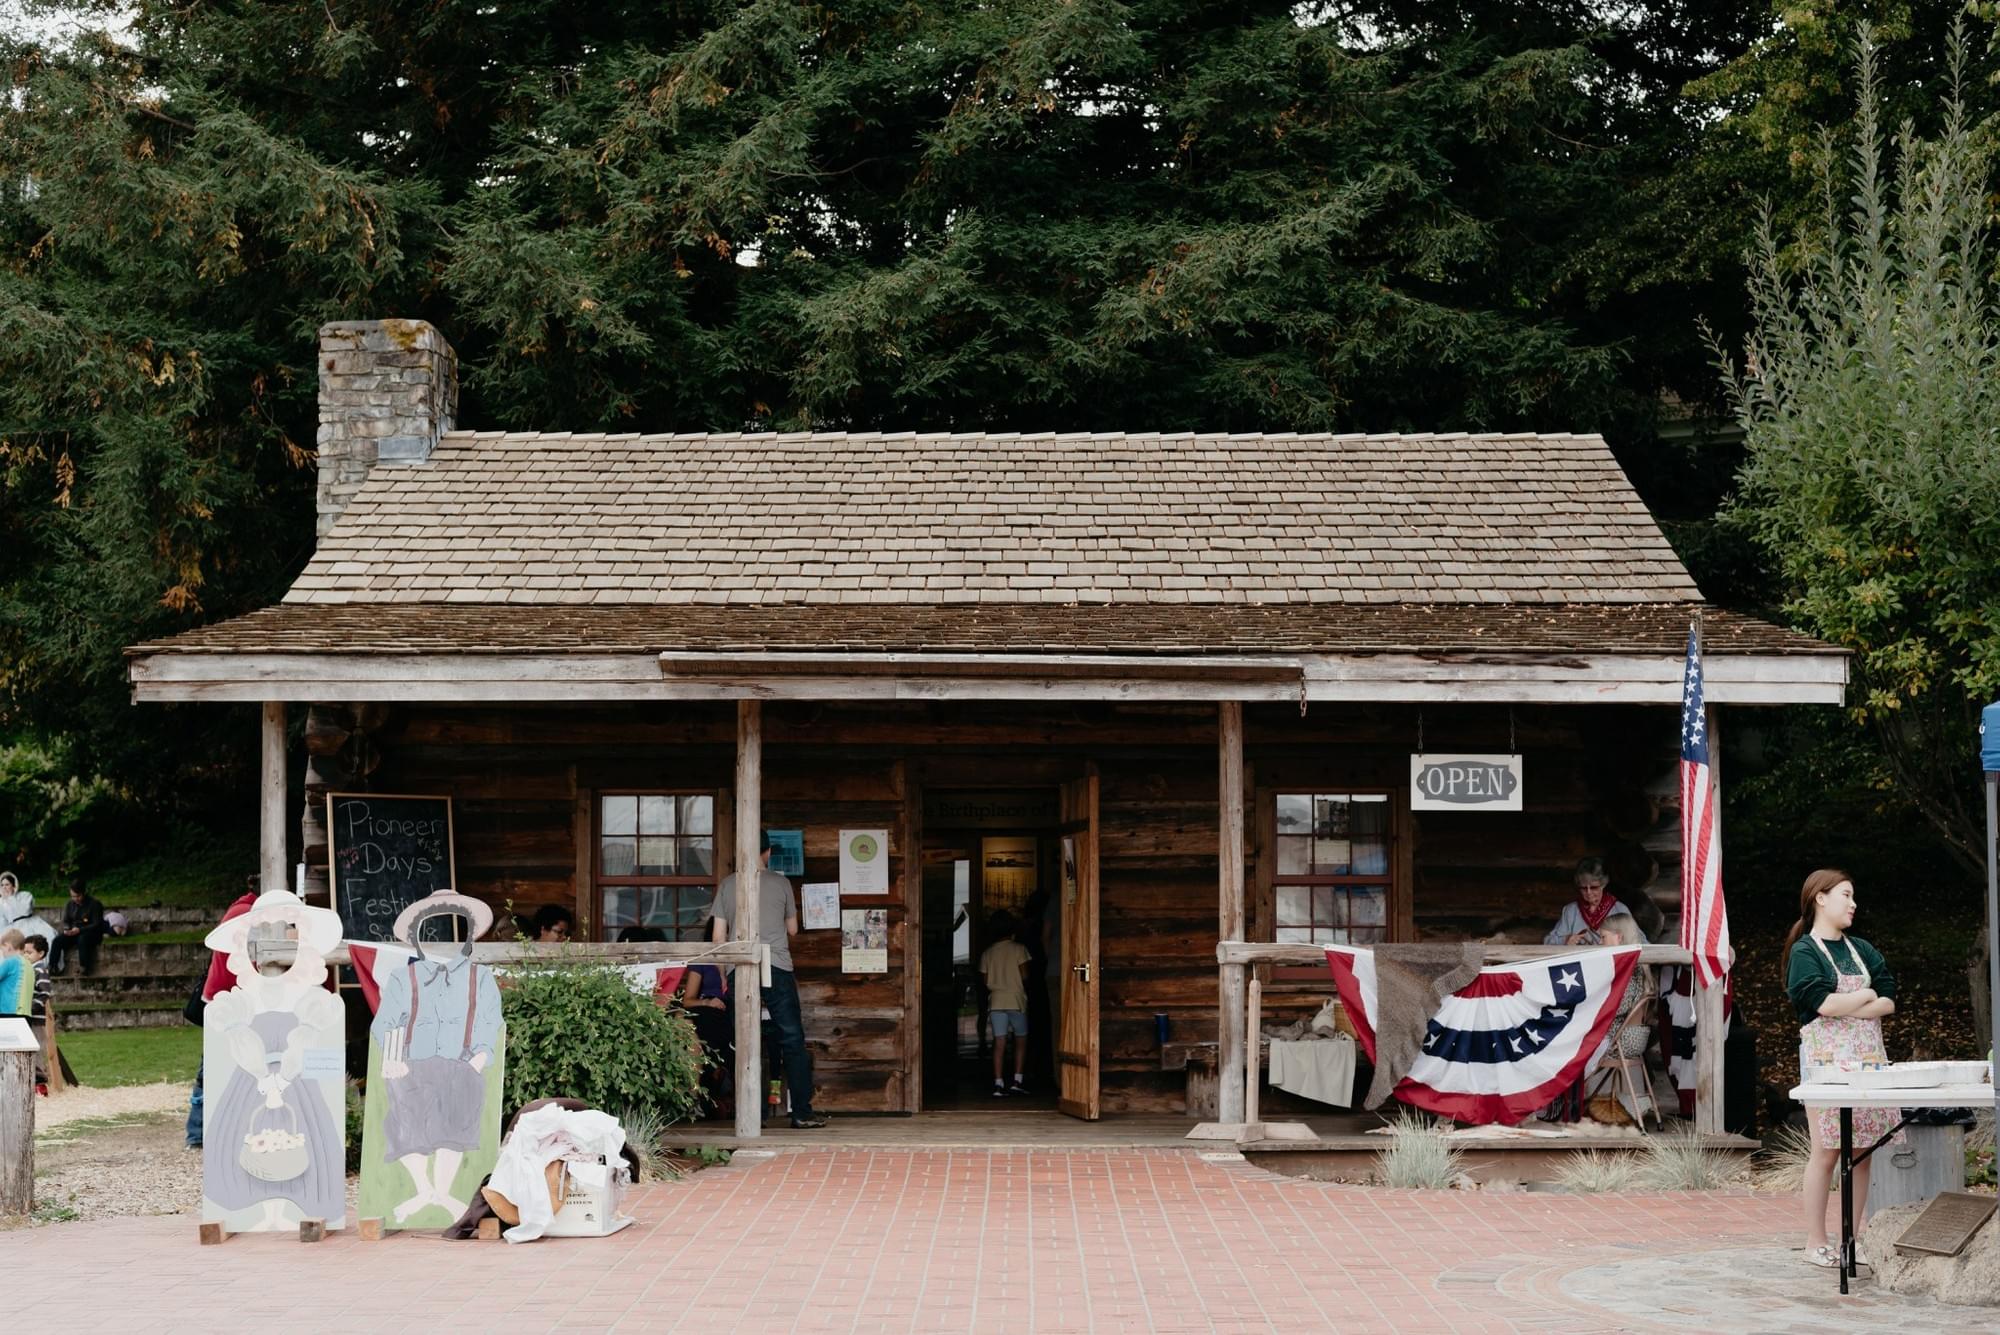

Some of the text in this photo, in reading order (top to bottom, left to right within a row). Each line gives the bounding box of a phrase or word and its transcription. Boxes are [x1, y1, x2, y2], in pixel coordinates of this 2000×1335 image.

[1426, 767, 1504, 796] OPEN
[337, 800, 441, 839] Pioneer
[939, 802, 1023, 821] Birthplace
[360, 842, 432, 880] Days
